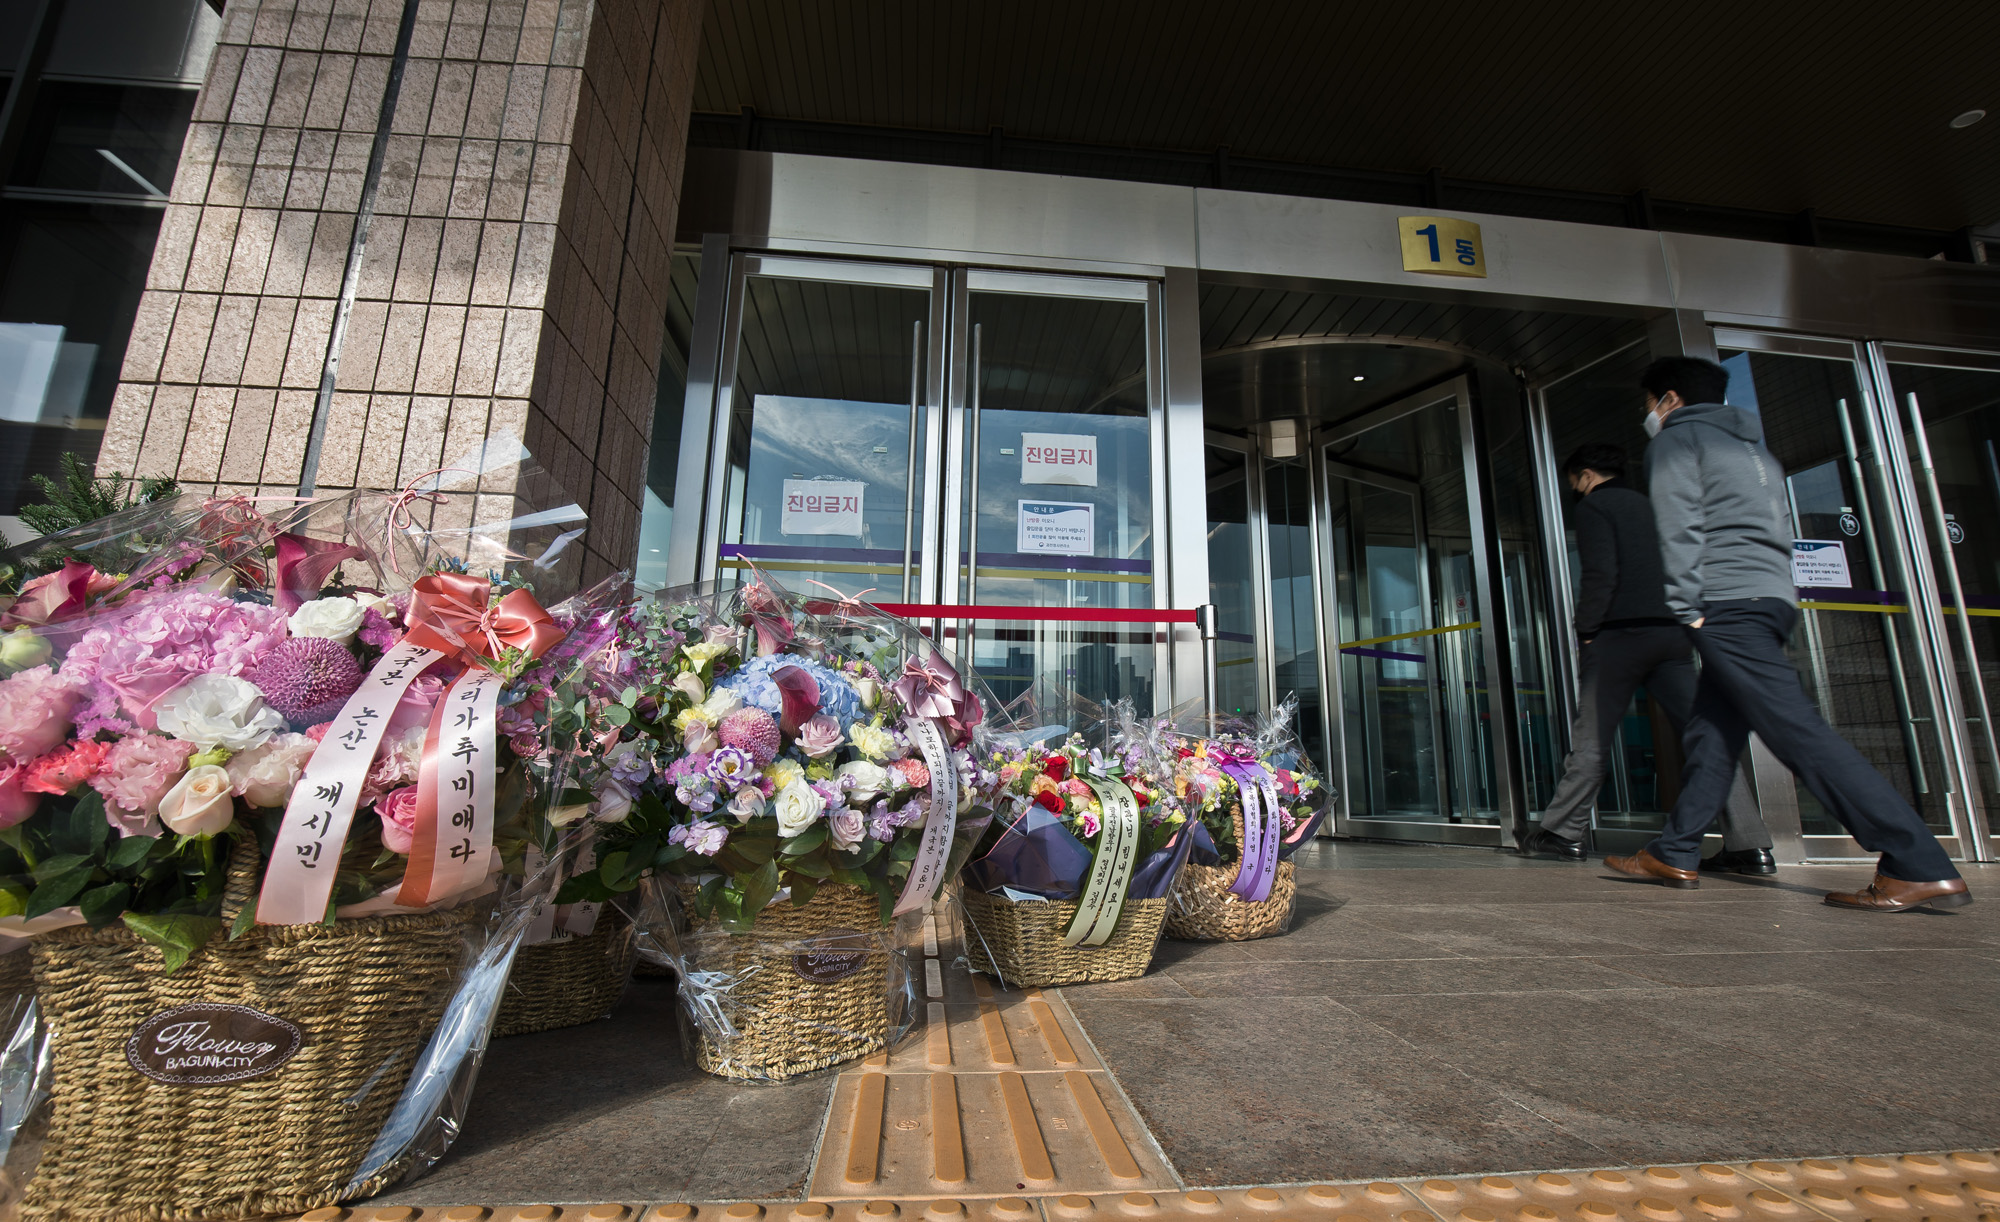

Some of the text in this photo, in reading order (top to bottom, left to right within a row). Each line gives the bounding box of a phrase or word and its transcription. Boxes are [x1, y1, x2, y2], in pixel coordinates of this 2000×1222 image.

[1026, 447, 1092, 466] 진입금지
[787, 495, 858, 514] 진입금지
[296, 646, 431, 869] 개국본 논산 깨시민
[1106, 796, 1133, 918] 장관님 힘내세요!
[807, 942, 860, 966] Flower
